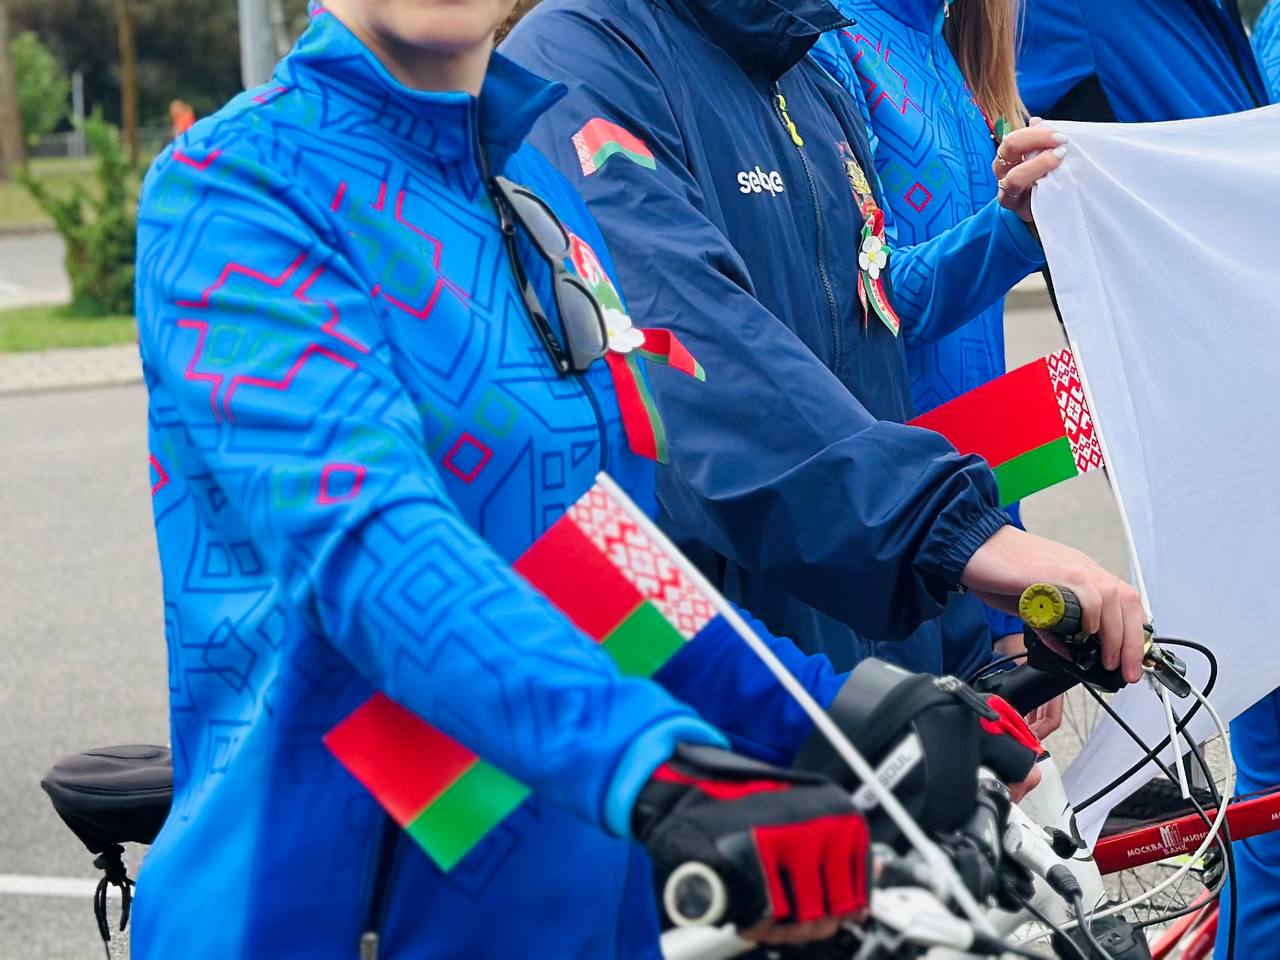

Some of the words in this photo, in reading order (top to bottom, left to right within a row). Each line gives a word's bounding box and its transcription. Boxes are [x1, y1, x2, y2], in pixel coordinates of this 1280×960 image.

[1127, 841, 1163, 857] МОСКВА
[1182, 831, 1210, 844] МИНС
[1163, 843, 1188, 856] БАНК
